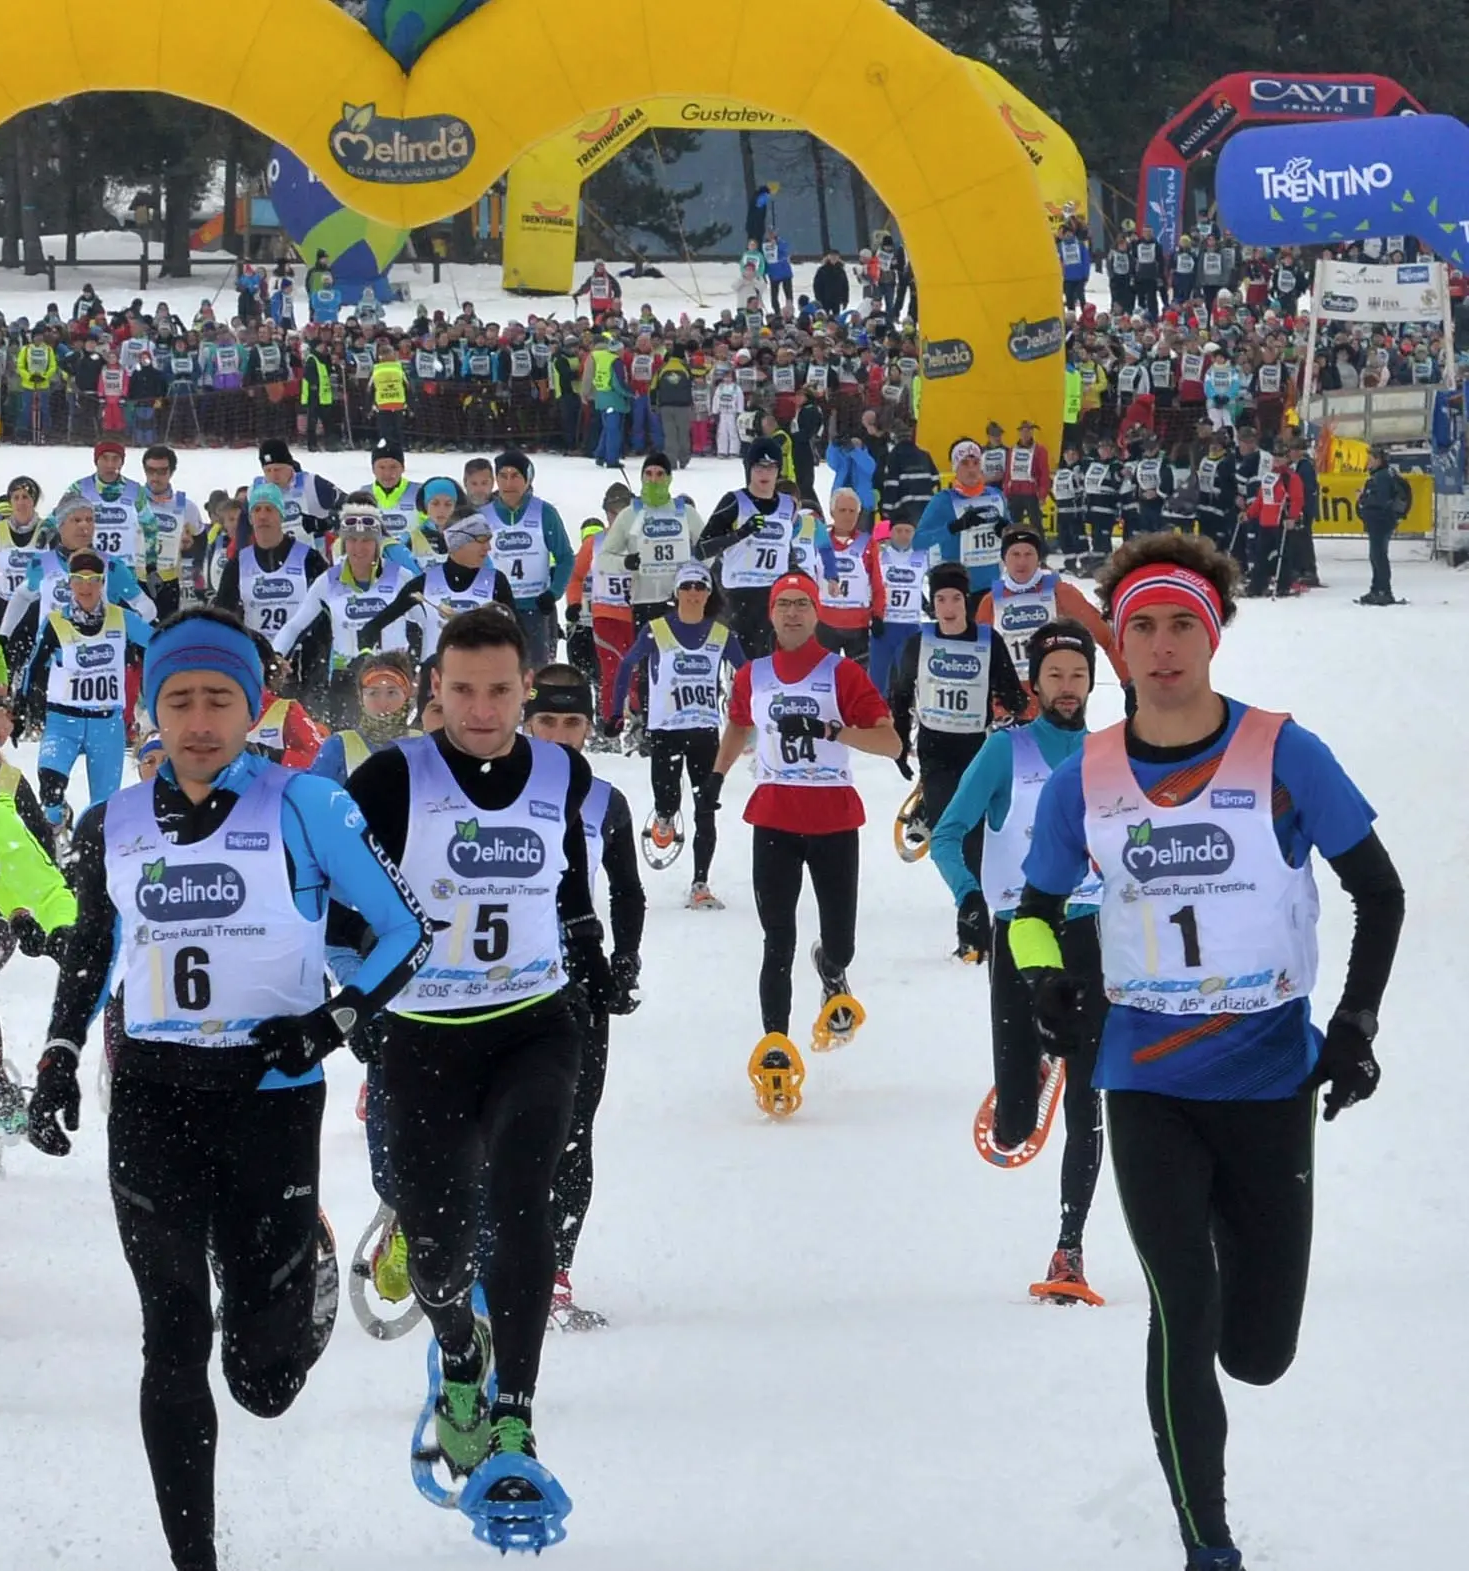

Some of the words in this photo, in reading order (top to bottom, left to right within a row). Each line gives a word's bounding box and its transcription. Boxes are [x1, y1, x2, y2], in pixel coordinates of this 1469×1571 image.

[1250, 79, 1375, 105] CAVIT
[1282, 103, 1344, 113] TRENTO
[333, 126, 468, 164] Melinda
[576, 107, 644, 168] TRENTINGRANA
[1255, 162, 1394, 203] TRENTINO
[1010, 324, 1062, 353] Melinda
[96, 531, 122, 553] 33
[974, 532, 996, 549] 115
[654, 544, 675, 562] 83
[755, 547, 778, 570] 70
[510, 558, 525, 580] 4
[890, 589, 911, 607] 57
[260, 607, 288, 631] 29
[1002, 606, 1046, 625] Melinda
[1010, 639, 1031, 662] 11
[931, 657, 980, 673] Melinda
[70, 674, 119, 702] 1006
[670, 684, 717, 712] 1005
[936, 688, 969, 712] 116
[770, 701, 819, 717] Melinda
[780, 735, 818, 765] 64
[1212, 792, 1254, 807] TRENTINO
[451, 837, 542, 864] Melinda
[1126, 834, 1229, 871] Melinda
[138, 873, 240, 908] Melinda
[458, 884, 488, 897] Casse
[487, 883, 517, 897] Rurali
[1141, 884, 1172, 897] Casse
[1172, 883, 1205, 897] Rurali
[1205, 881, 1257, 896] Trentine
[180, 926, 213, 940] Rurali
[214, 924, 266, 939] Trentine
[472, 903, 510, 963] 5
[1168, 904, 1203, 969] 1
[407, 940, 433, 972] TSL
[173, 945, 212, 1012] 6
[1210, 993, 1270, 1012] edizione
